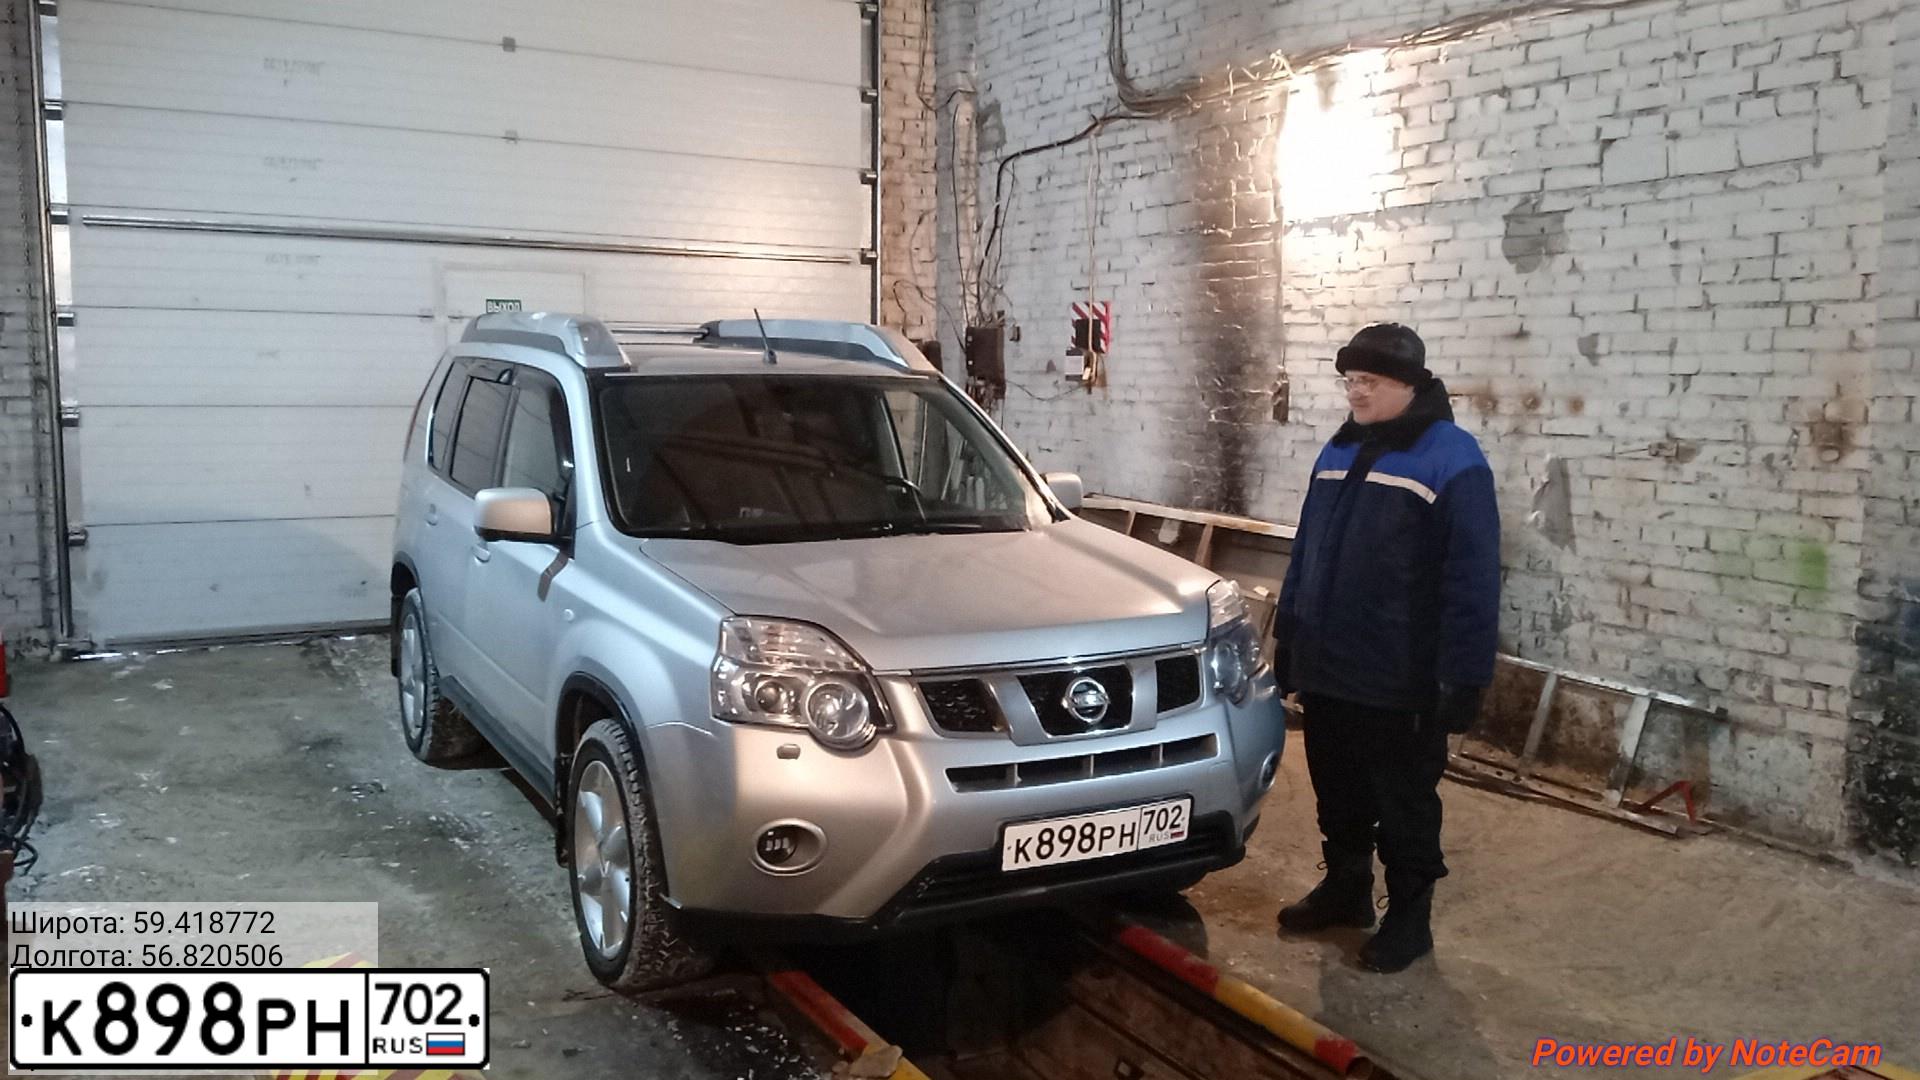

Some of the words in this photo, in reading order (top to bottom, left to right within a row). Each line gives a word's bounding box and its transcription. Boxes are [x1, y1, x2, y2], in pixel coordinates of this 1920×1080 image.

[1014, 822, 1137, 864] К898РН
[1143, 805, 1183, 834] 702
[1149, 832, 1170, 843] RUS
